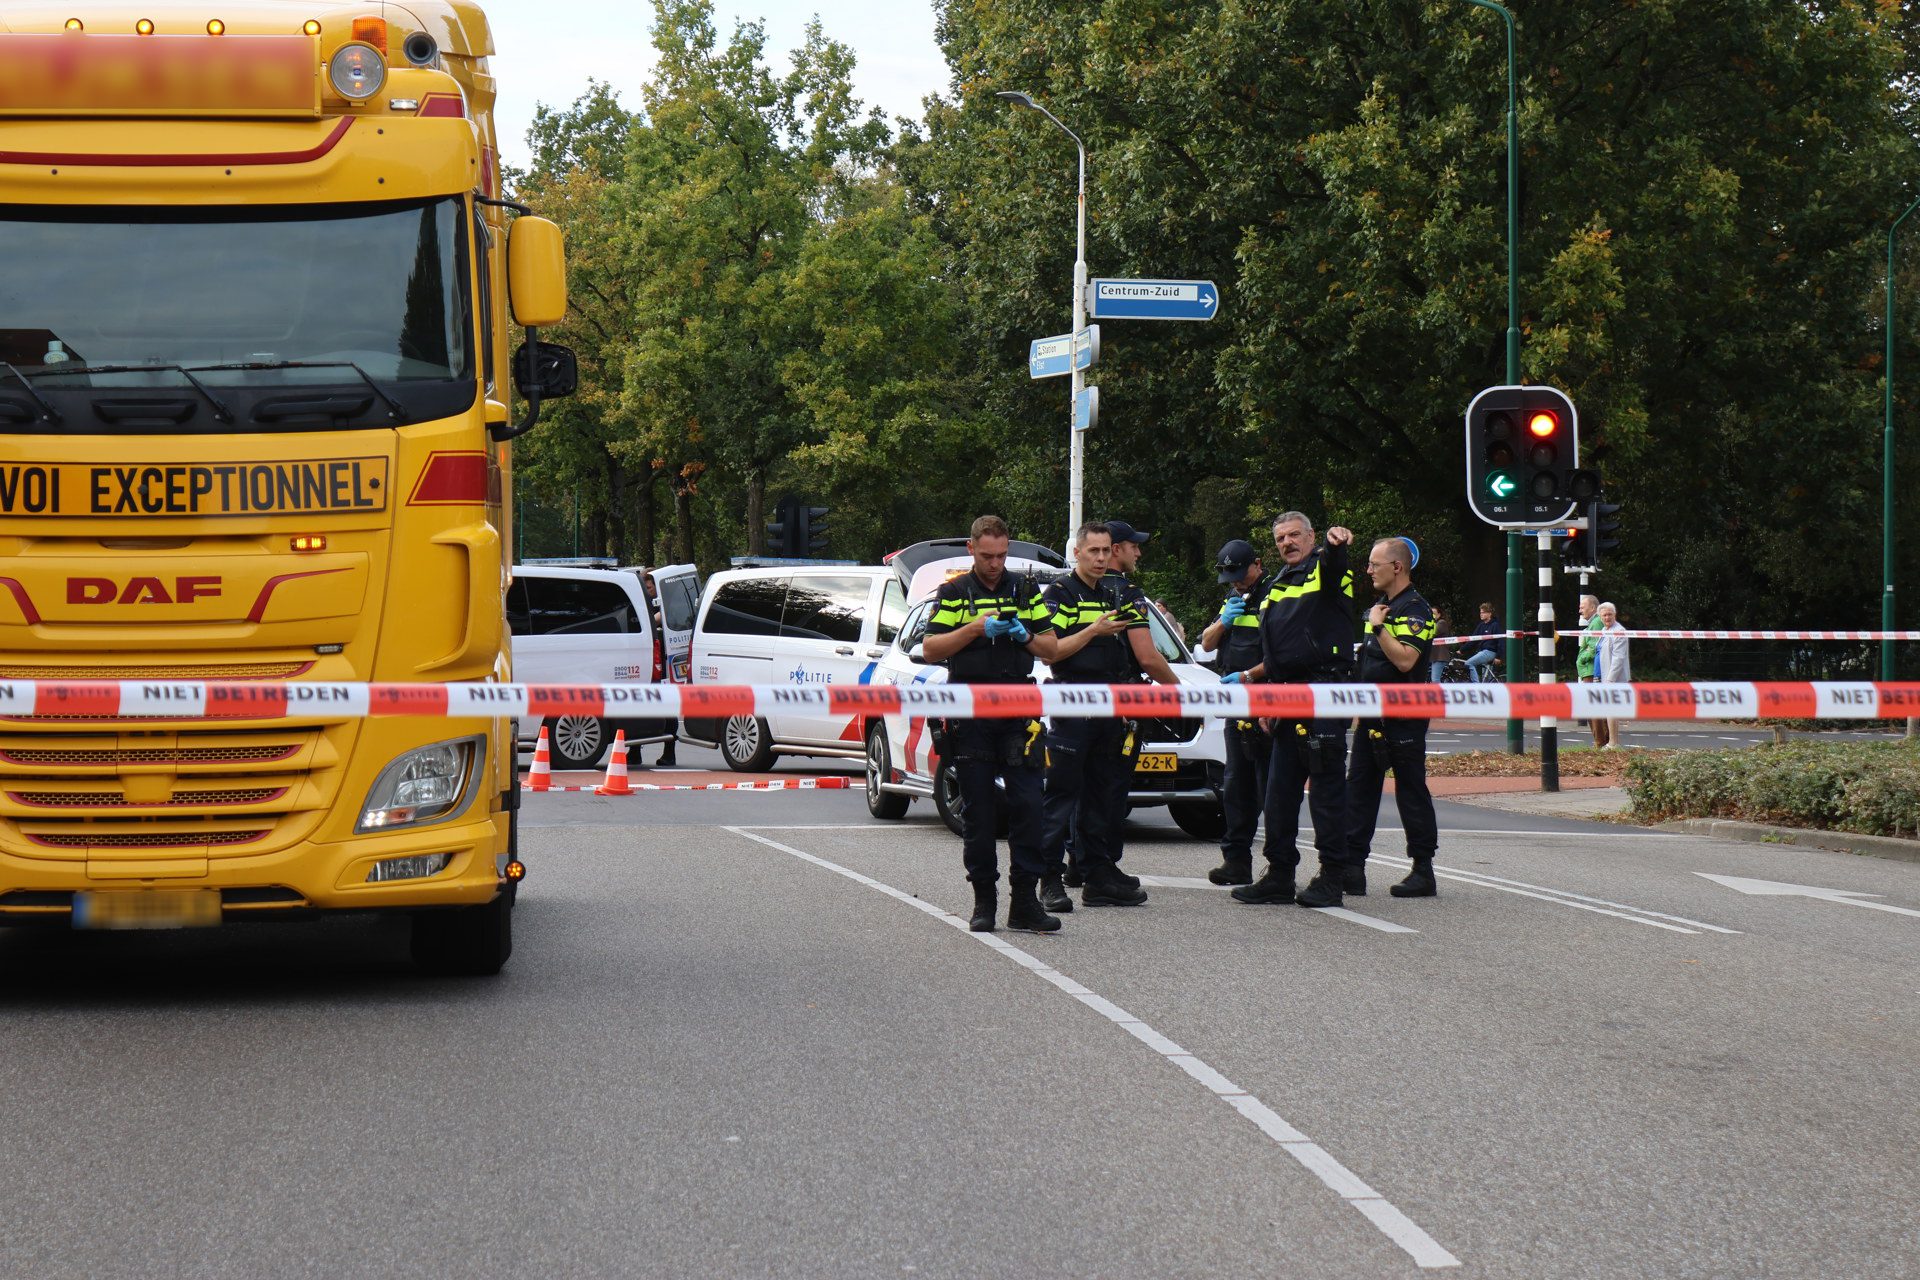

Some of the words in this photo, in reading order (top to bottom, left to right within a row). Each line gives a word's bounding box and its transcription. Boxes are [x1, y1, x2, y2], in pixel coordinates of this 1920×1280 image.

[1101, 285, 1180, 297] Centrum-Zuid
[0, 466, 60, 513] VOI
[91, 462, 374, 513] EXCEPTIONNEL
[66, 576, 222, 604] DAF
[669, 634, 691, 644] POLITI
[628, 665, 640, 674] 112
[143, 686, 200, 699] NIET
[213, 686, 350, 700] BETREDEN
[468, 687, 524, 701] NIET
[534, 687, 662, 702] BETREDEN
[772, 689, 826, 703] NIET
[835, 689, 956, 703] BETREDEN
[1060, 690, 1110, 704] NIET
[1118, 690, 1233, 704] BETREDEN
[1331, 690, 1378, 704] NIET
[1386, 690, 1494, 704] BETREDEN
[1587, 690, 1632, 704] NIET
[1641, 690, 1743, 704] BETREDEN
[1832, 690, 1875, 704] NIET
